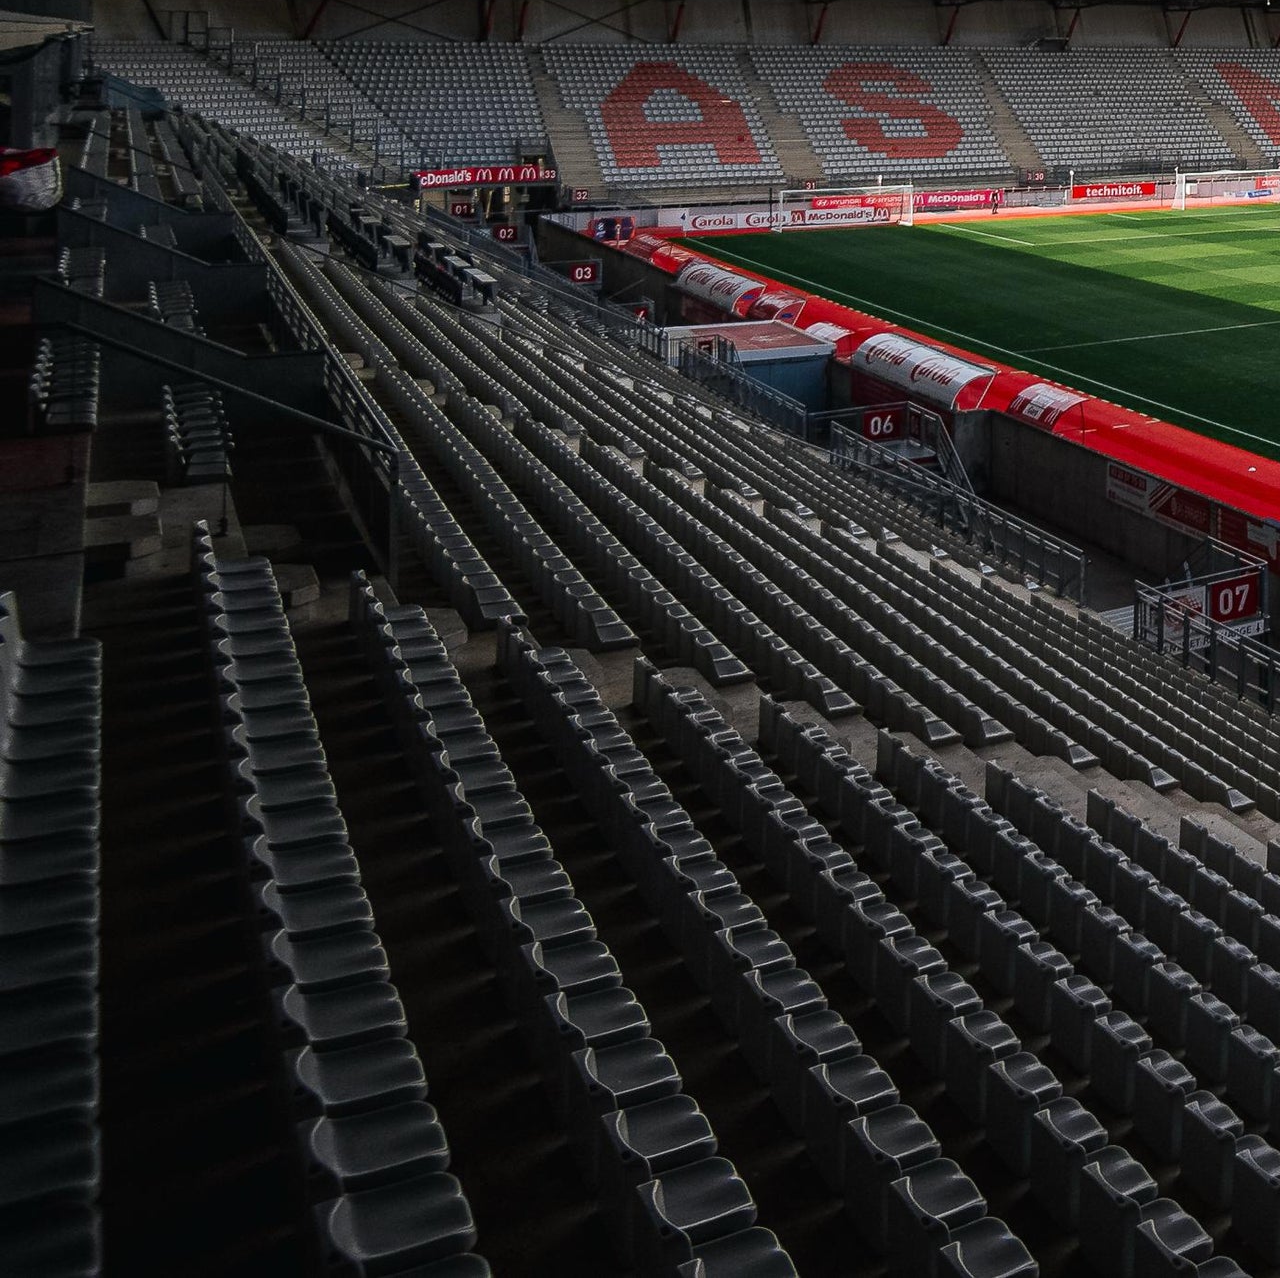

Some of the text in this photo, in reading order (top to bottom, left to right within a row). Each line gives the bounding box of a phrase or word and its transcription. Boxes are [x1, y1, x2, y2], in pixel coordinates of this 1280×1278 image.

[419, 169, 472, 186] cDonald's
[544, 170, 556, 179] 33
[1034, 173, 1044, 181] 30
[576, 191, 588, 201] 32
[927, 193, 985, 204] McDonald's
[455, 204, 468, 214] 01
[807, 210, 872, 221] McDonald's
[691, 215, 734, 229] Carola
[499, 228, 514, 239] 02
[574, 266, 593, 280] 03
[870, 414, 894, 436] 06
[1219, 583, 1250, 615] 07
